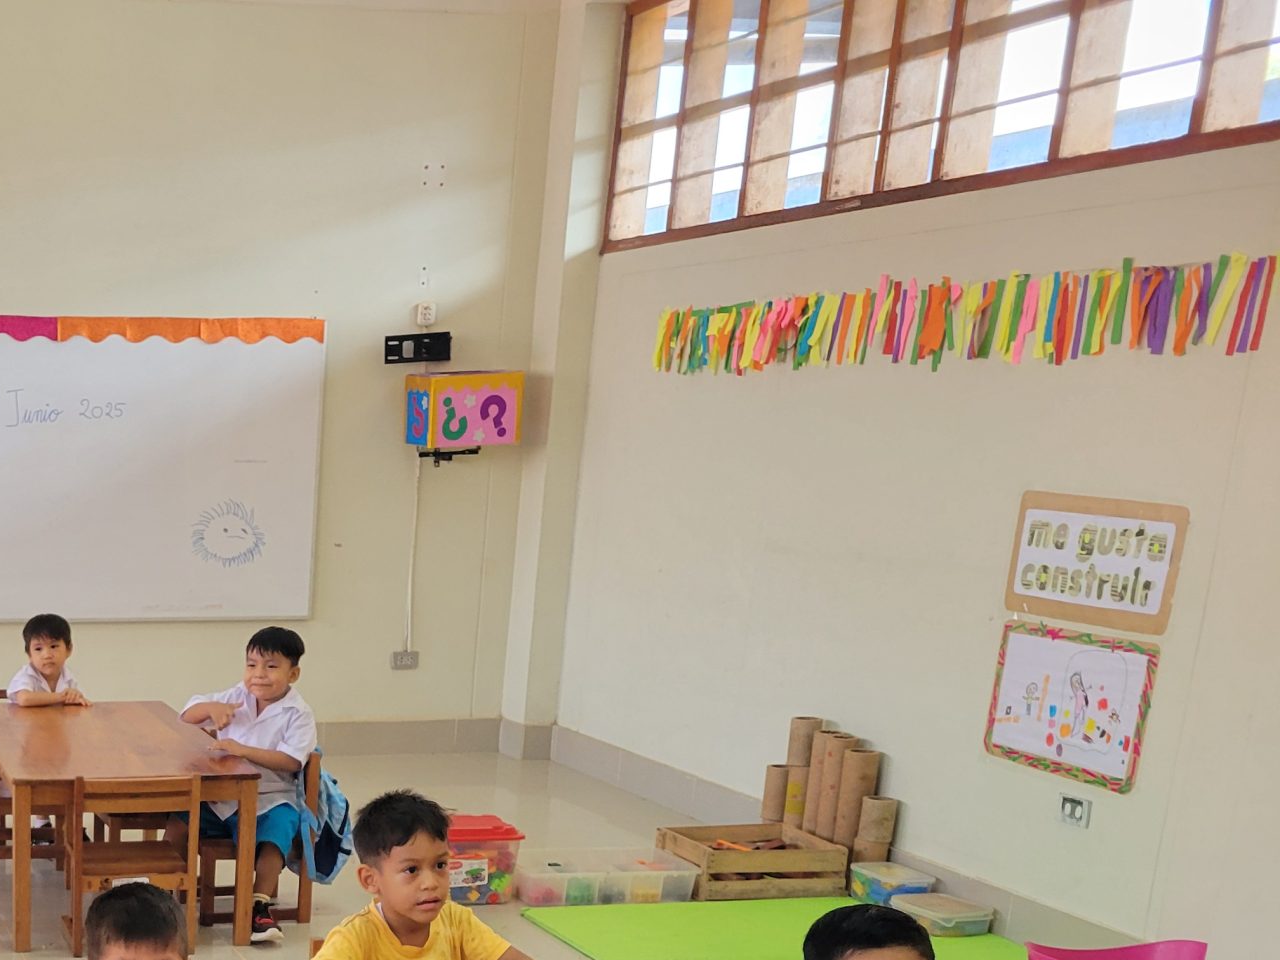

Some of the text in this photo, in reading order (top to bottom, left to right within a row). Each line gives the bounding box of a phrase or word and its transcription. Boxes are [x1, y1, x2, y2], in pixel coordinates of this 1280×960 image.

[6, 388, 64, 428] Junio
[78, 398, 127, 420] 2025
[1027, 520, 1169, 563] me gusta
[1021, 563, 1157, 608] construir
